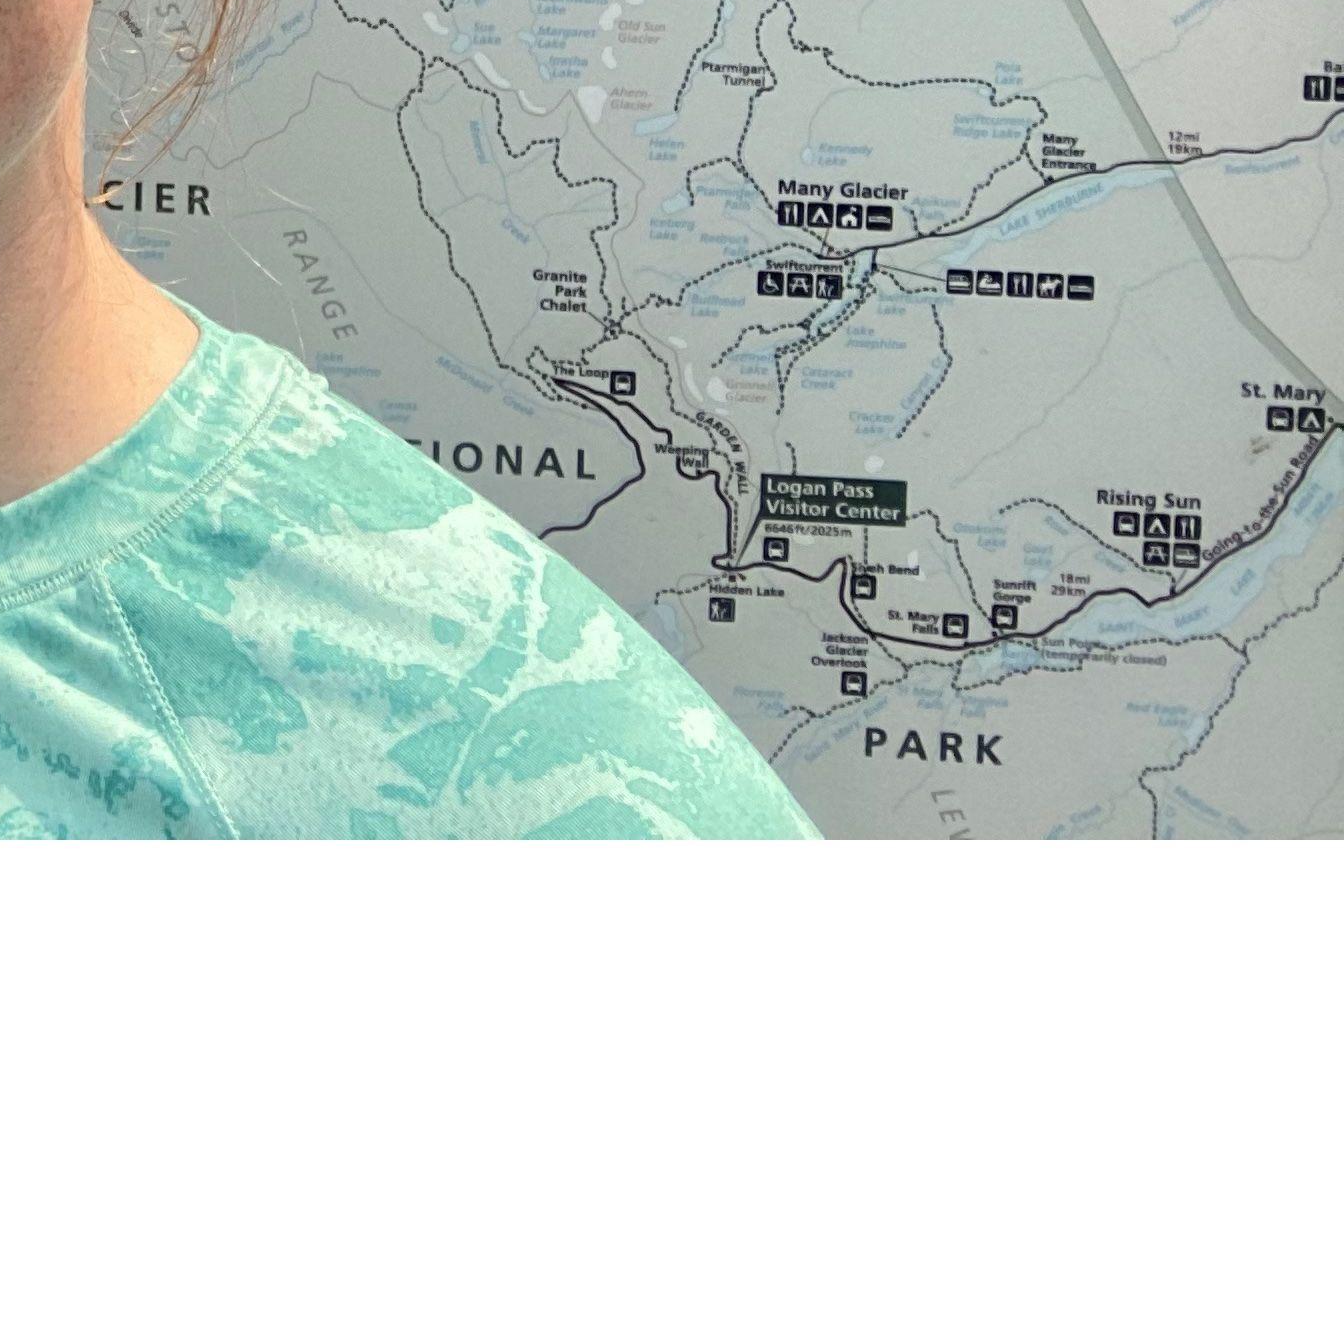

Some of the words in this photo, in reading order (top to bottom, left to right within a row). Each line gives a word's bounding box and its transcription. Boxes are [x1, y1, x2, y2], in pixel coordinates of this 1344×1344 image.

[701, 61, 766, 75] Ptarmigan
[722, 74, 766, 87] Tunnel
[1042, 133, 1079, 146] Many
[1041, 145, 1086, 157] Glacier
[1041, 158, 1097, 171] Entrance
[778, 179, 834, 201] Many
[839, 182, 909, 201] Glacier
[764, 260, 844, 273] Swiftcurrent
[532, 269, 587, 283] Granite
[283, 229, 359, 341] RANGE
[554, 285, 587, 297] Park
[539, 299, 587, 313] Chalet
[552, 365, 575, 376] The
[579, 367, 610, 380] Loop
[1240, 381, 1267, 399] St.
[1272, 384, 1327, 405] Mary
[653, 443, 711, 457] Weeping
[695, 411, 743, 454] GARDEN
[735, 461, 750, 496] WALL
[1289, 435, 1320, 469] Road
[766, 478, 827, 499] Logan
[832, 481, 875, 499] Pass
[1095, 489, 1157, 512] Rising
[1163, 492, 1202, 511] Sun
[765, 499, 831, 517] Visitor
[835, 502, 901, 521] Center
[888, 564, 920, 576] Bend
[708, 584, 754, 597] Hidden
[756, 585, 785, 597] Lake
[993, 579, 1037, 592] Sunrift
[992, 592, 1032, 605] Gorge
[887, 610, 904, 621] St.
[908, 611, 940, 625] Mary
[912, 623, 939, 635] Falls
[821, 631, 869, 644] Jackson
[825, 644, 870, 657] Glacier
[811, 656, 868, 669] Overlook
[865, 726, 1004, 766] PARK
